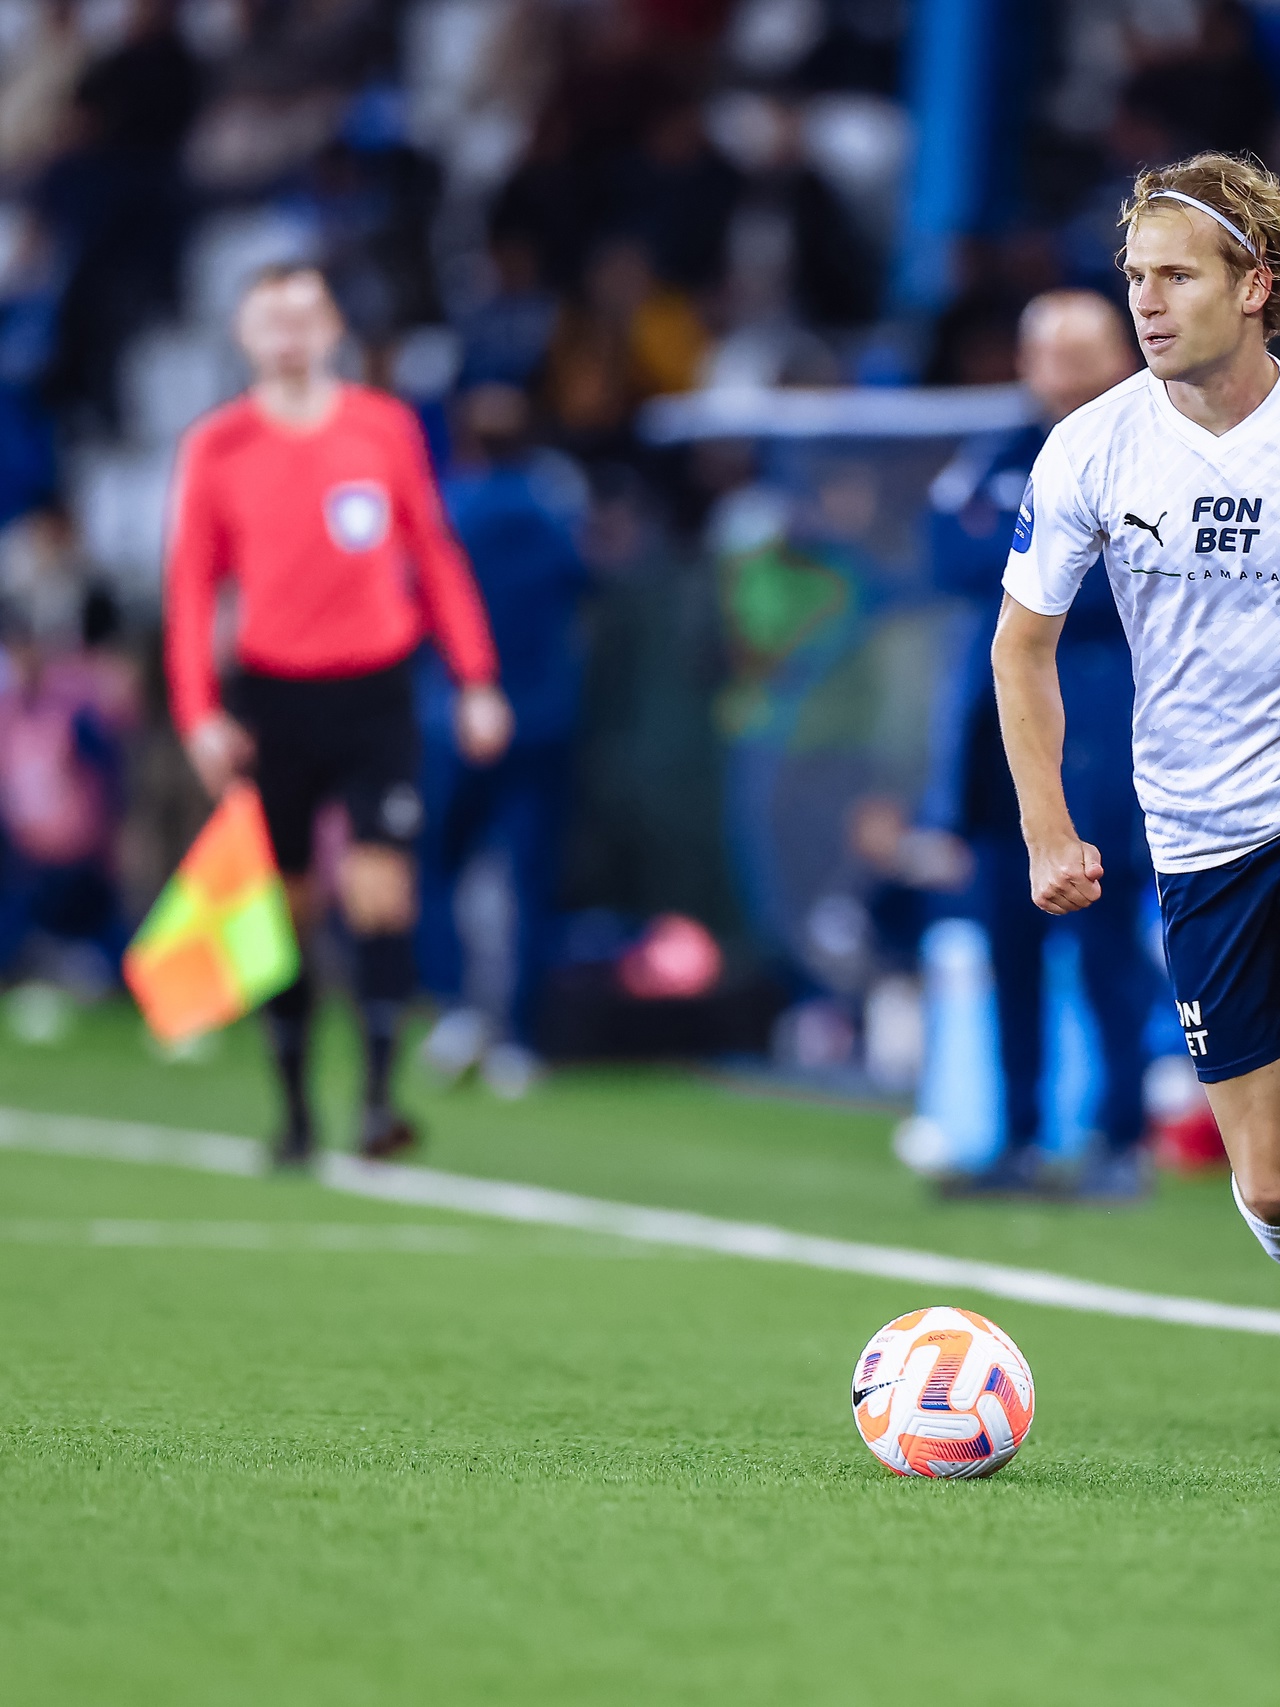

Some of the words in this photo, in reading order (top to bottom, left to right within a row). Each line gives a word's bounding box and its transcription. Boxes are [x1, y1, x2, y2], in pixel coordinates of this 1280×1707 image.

[1192, 496, 1263, 523] FON
[1195, 527, 1261, 554] BET
[1187, 569, 1280, 582] САМАРА
[1184, 1029, 1209, 1057] ET
